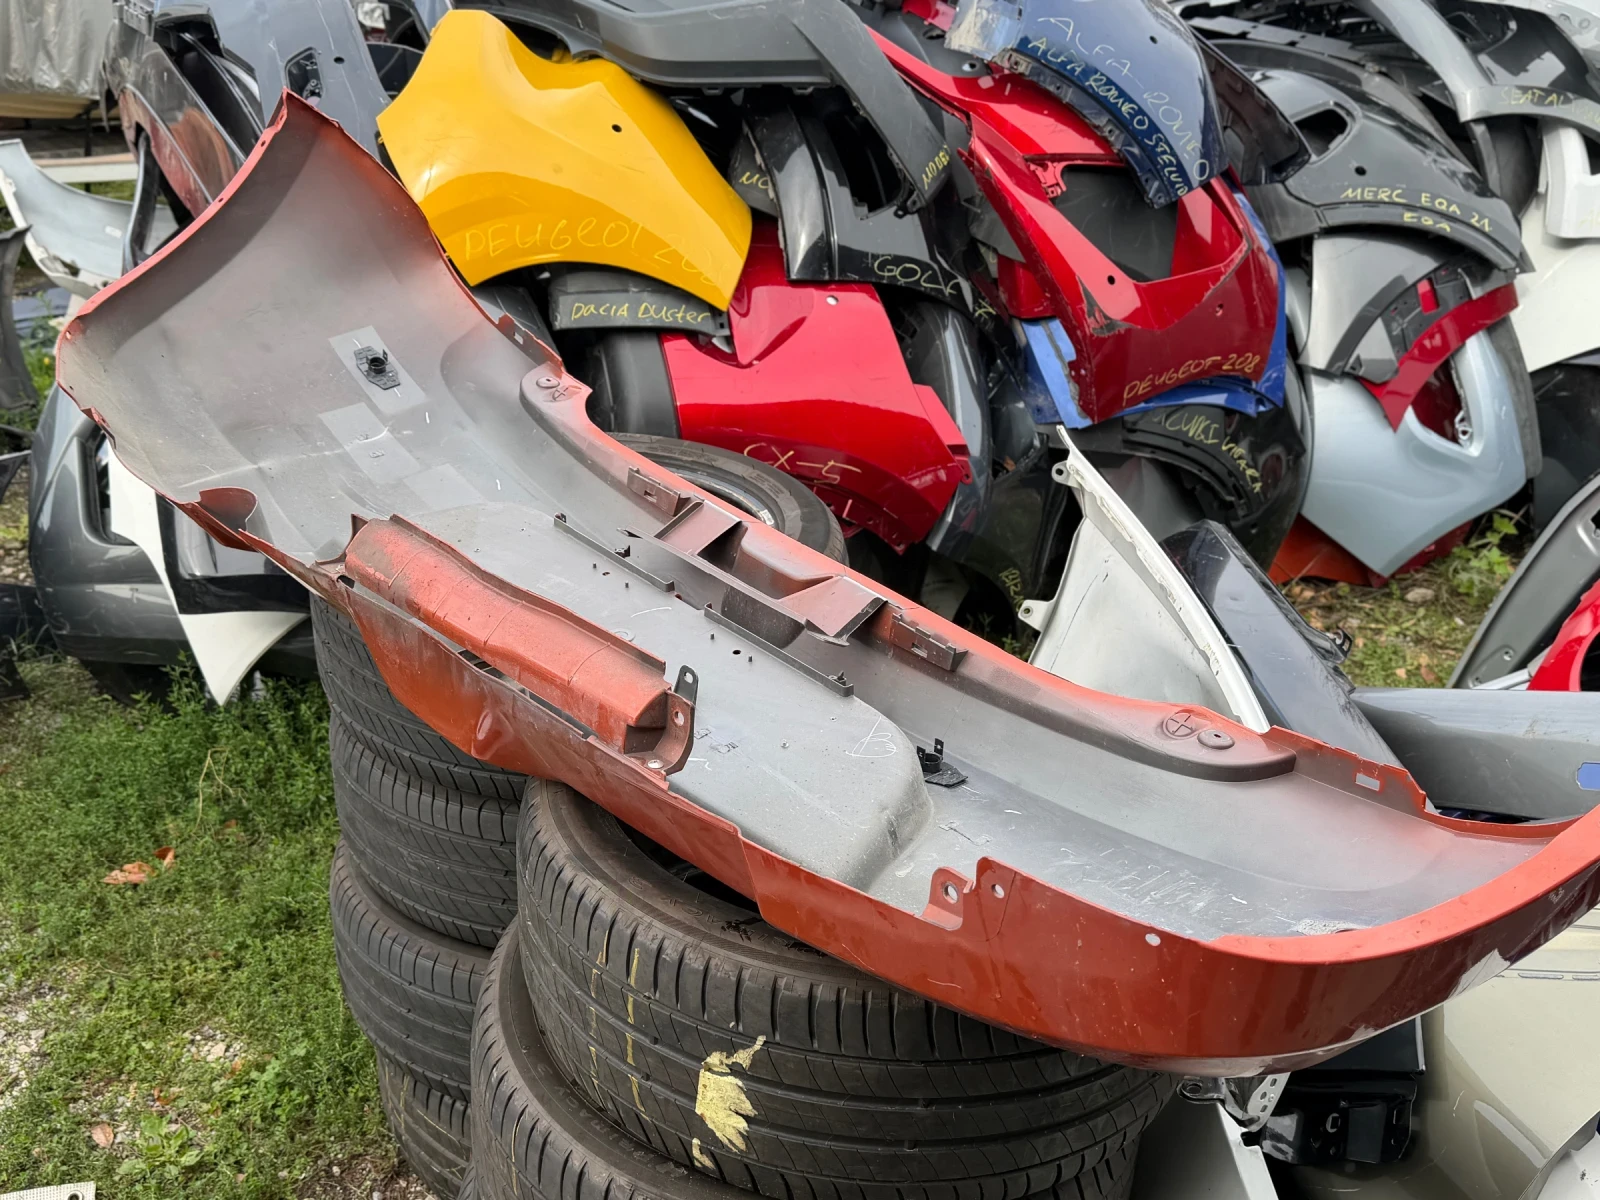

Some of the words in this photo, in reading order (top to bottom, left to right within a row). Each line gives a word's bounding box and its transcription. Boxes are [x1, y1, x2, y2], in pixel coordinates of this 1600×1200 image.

[1028, 37, 1086, 76] ALFA
[1085, 72, 1149, 130] ROMEO
[1144, 133, 1188, 196] STELVIO
[1498, 87, 1545, 105] SEAT
[1340, 187, 1407, 203] MERC
[1421, 192, 1461, 215] EQA
[1403, 211, 1451, 232] EQA
[874, 255, 962, 296] GOLF
[1122, 356, 1221, 406] PEUGEOT
[1222, 353, 1260, 373] 208
[743, 442, 862, 484] CX-5
